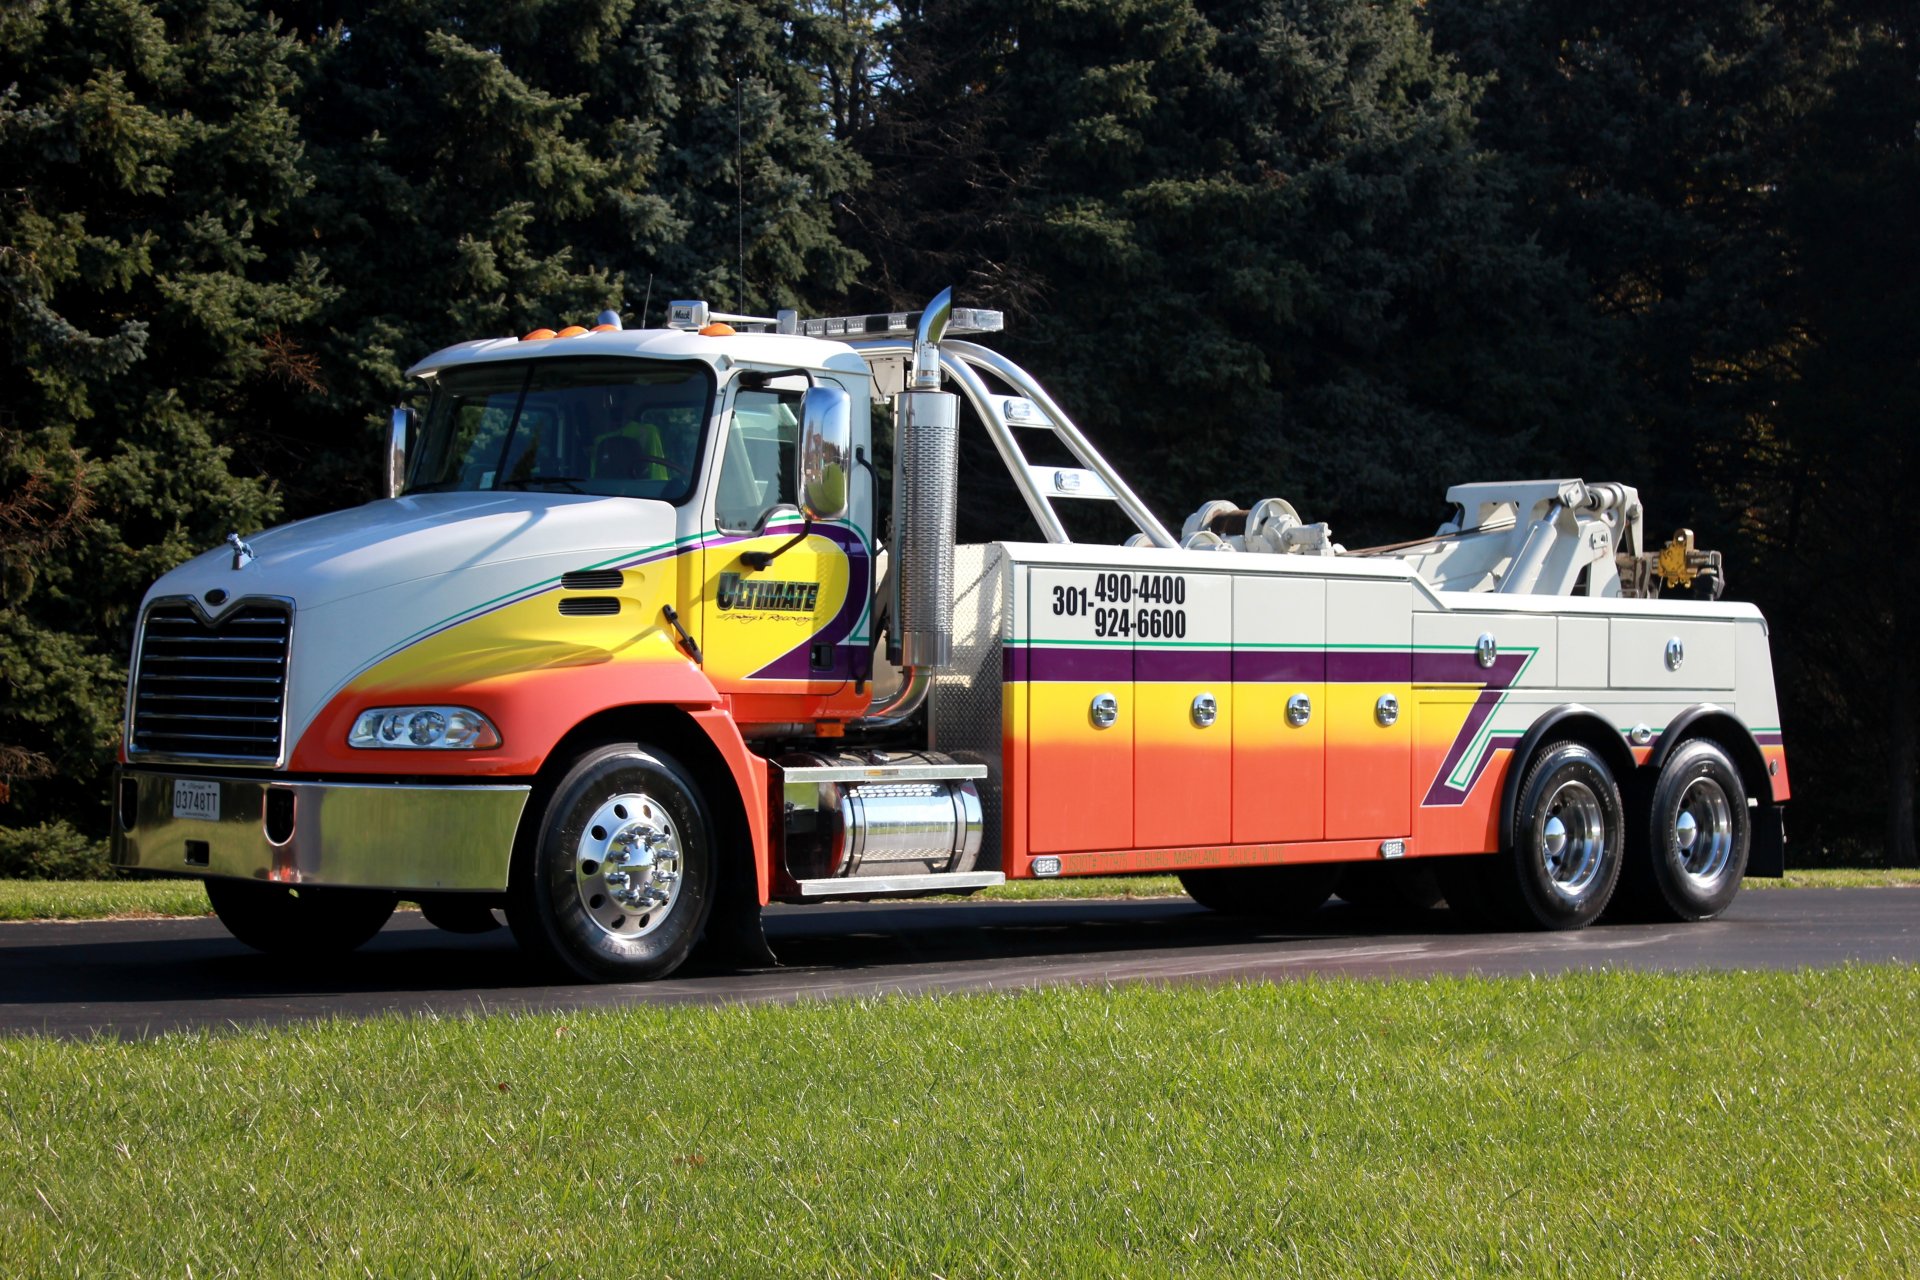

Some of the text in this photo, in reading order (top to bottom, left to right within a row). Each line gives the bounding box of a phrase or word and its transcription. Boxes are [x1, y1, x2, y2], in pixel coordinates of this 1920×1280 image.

[716, 572, 820, 612] ULTIMATE
[1053, 573, 1186, 616] 301- 490-4400
[1095, 607, 1187, 639] 924-6600
[175, 790, 217, 812] 03748TT
[1173, 847, 1220, 866] MARYLAND
